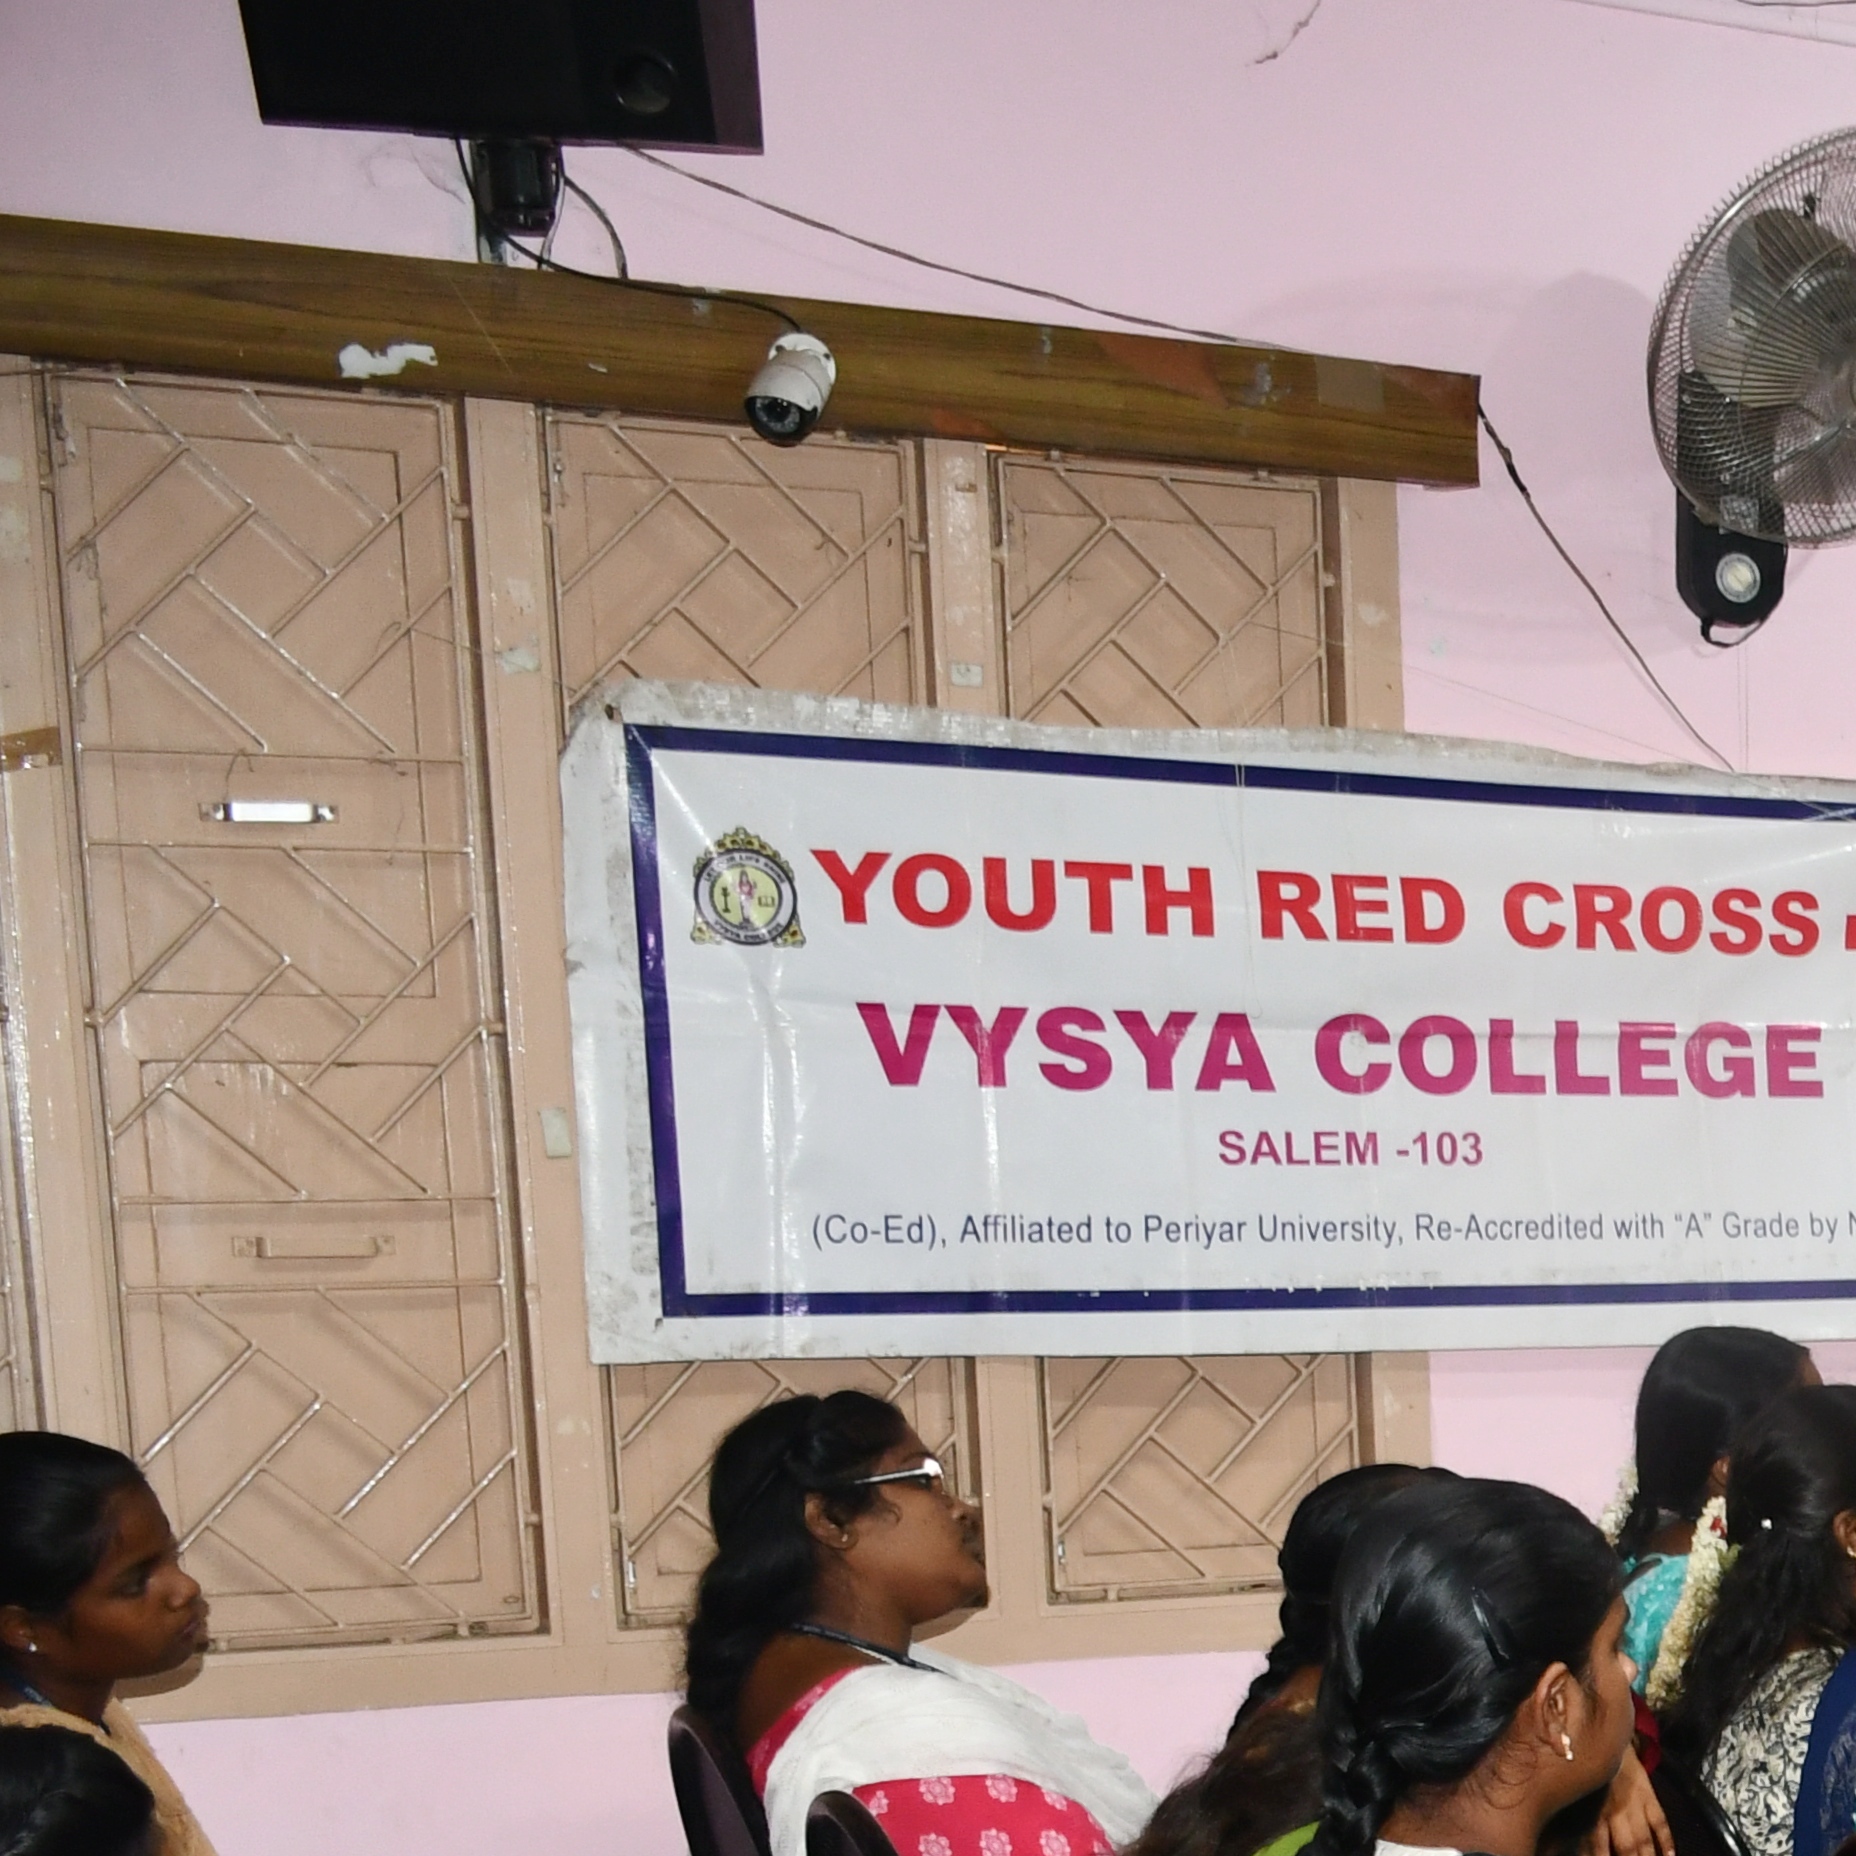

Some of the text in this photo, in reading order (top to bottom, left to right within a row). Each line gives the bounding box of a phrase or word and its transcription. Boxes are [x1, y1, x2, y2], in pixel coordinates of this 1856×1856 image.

[809, 848, 1820, 957] YOUTH RED CROSS
[855, 1001, 1825, 1099] VYSYA COLLEGE
[1217, 1129, 1484, 1167] SALEM -103
[812, 1213, 948, 1251] (Co-Ed),
[959, 1213, 1093, 1245] Affiliated
[1105, 1216, 1133, 1245] to
[1144, 1213, 1248, 1250] Periyar
[1258, 1211, 1404, 1248] University,
[1415, 1211, 1605, 1242] Re-Accredited
[1613, 1212, 1665, 1240] with
[1722, 1210, 1801, 1239] Grade
[1809, 1210, 1839, 1244] by
